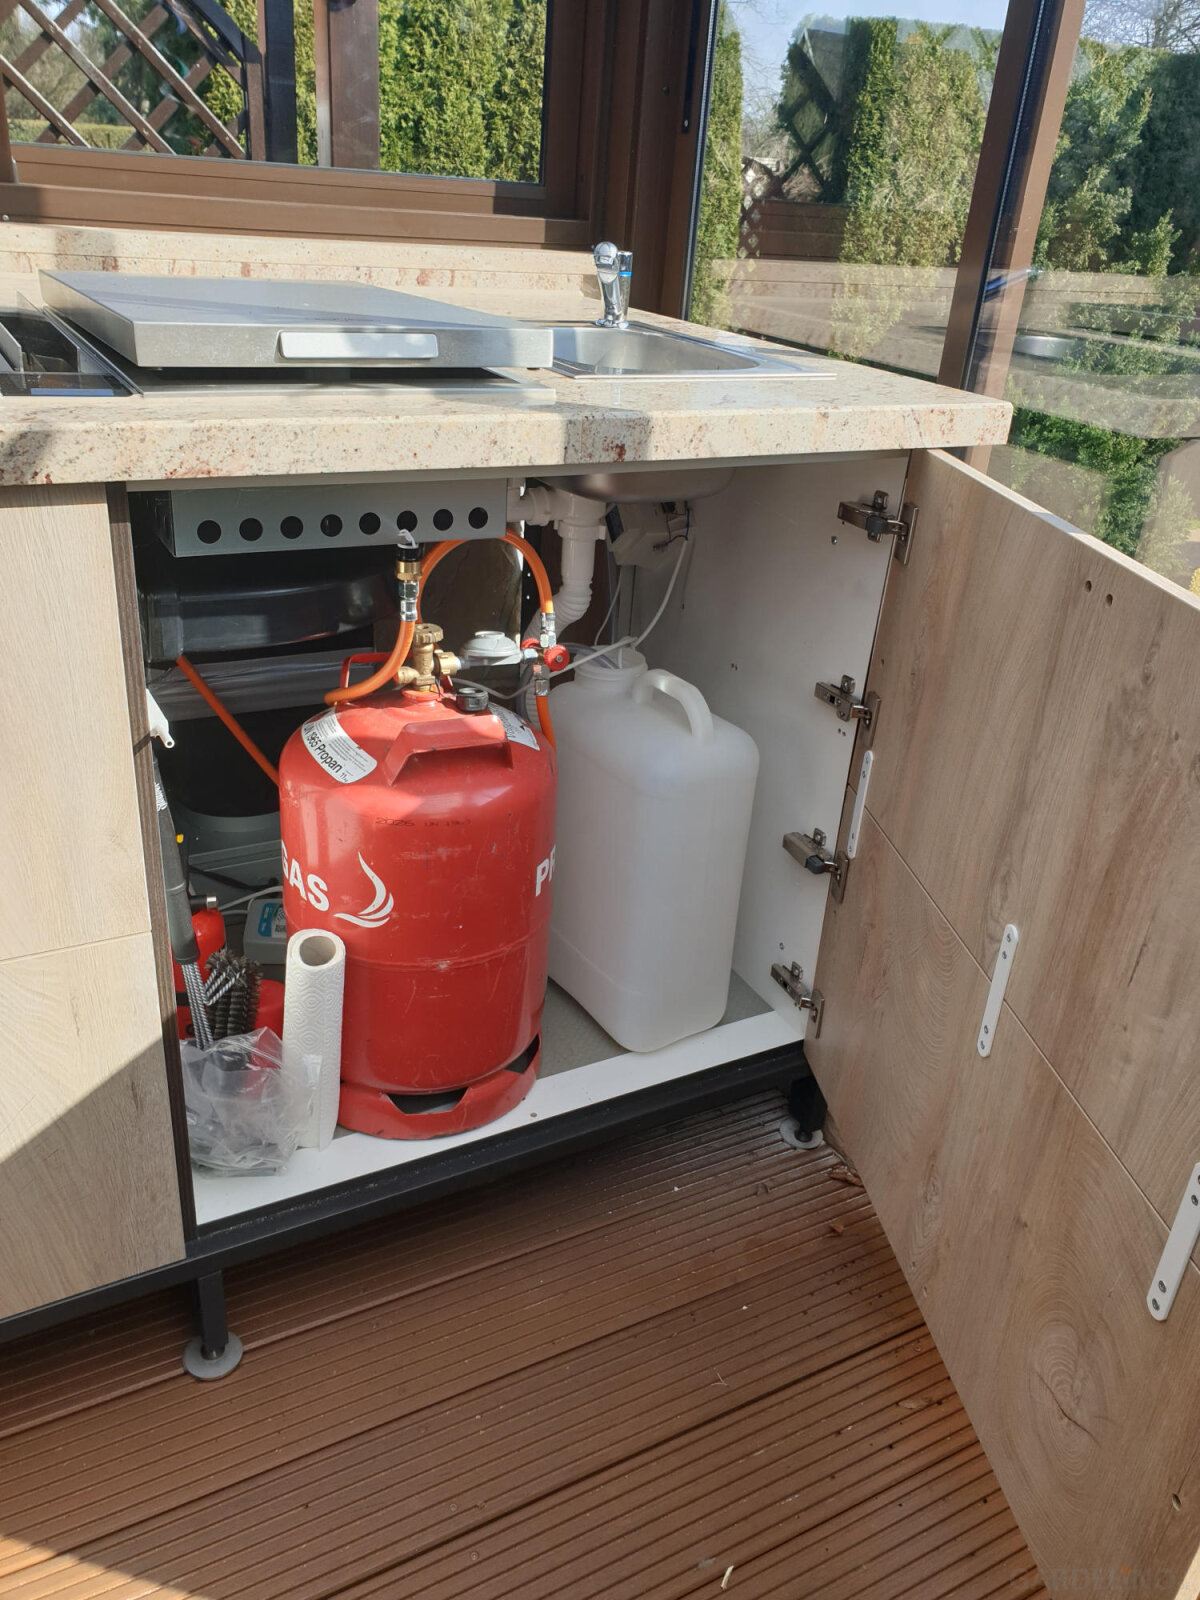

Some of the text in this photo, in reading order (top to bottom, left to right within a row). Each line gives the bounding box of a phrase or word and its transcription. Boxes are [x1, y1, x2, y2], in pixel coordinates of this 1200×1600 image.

[306, 731, 322, 748] 1965
[314, 743, 342, 773] Propan
[281, 840, 329, 911] GAS
